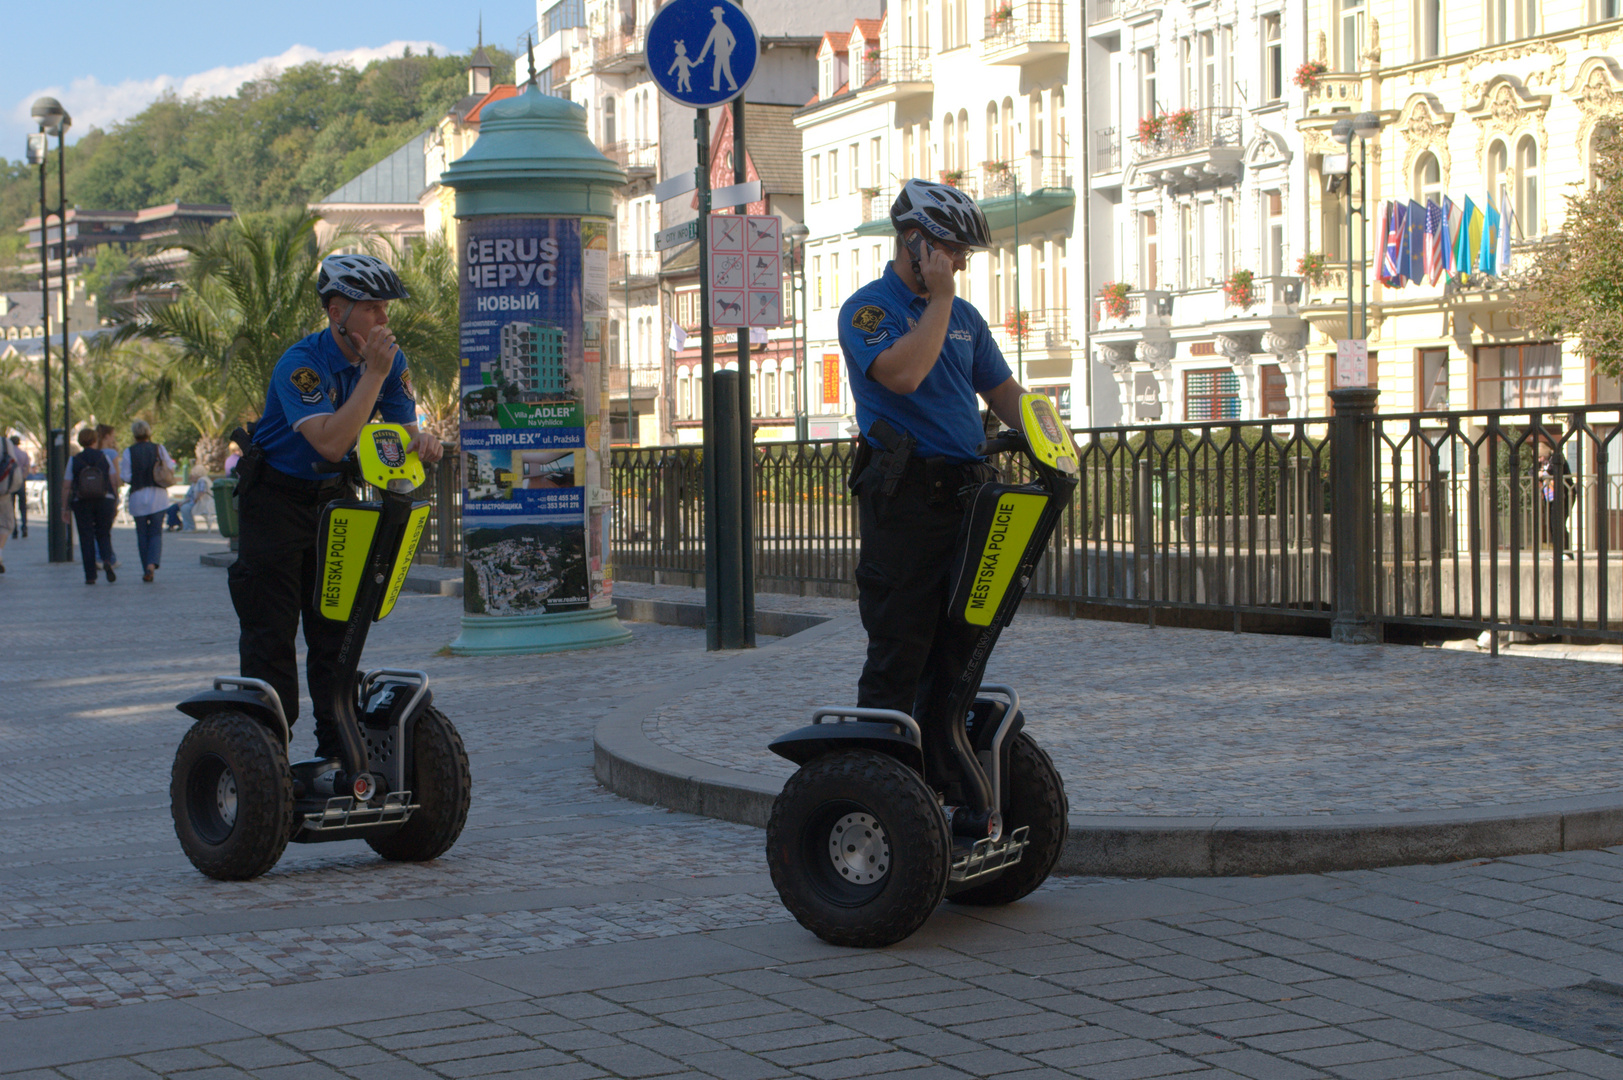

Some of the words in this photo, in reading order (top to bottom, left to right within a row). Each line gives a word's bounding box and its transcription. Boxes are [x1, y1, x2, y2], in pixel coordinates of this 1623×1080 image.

[666, 232, 676, 243] CITY
[678, 227, 689, 239] INFO
[913, 211, 950, 237] POLICIE
[467, 236, 559, 264] ČERUS
[467, 263, 557, 288] ЧЕРУС
[332, 281, 366, 298] POLICIE
[477, 292, 539, 312] НОВЫЙ
[553, 435, 580, 444] Pražská
[332, 518, 349, 558] POLICIE
[402, 516, 426, 564] MĚSTSKÁ
[970, 553, 1000, 609] MĚSTSKÁ
[990, 503, 1015, 551] POLICIE
[323, 559, 344, 608] MĚSTSKÁ
[387, 566, 407, 605] POLICIE
